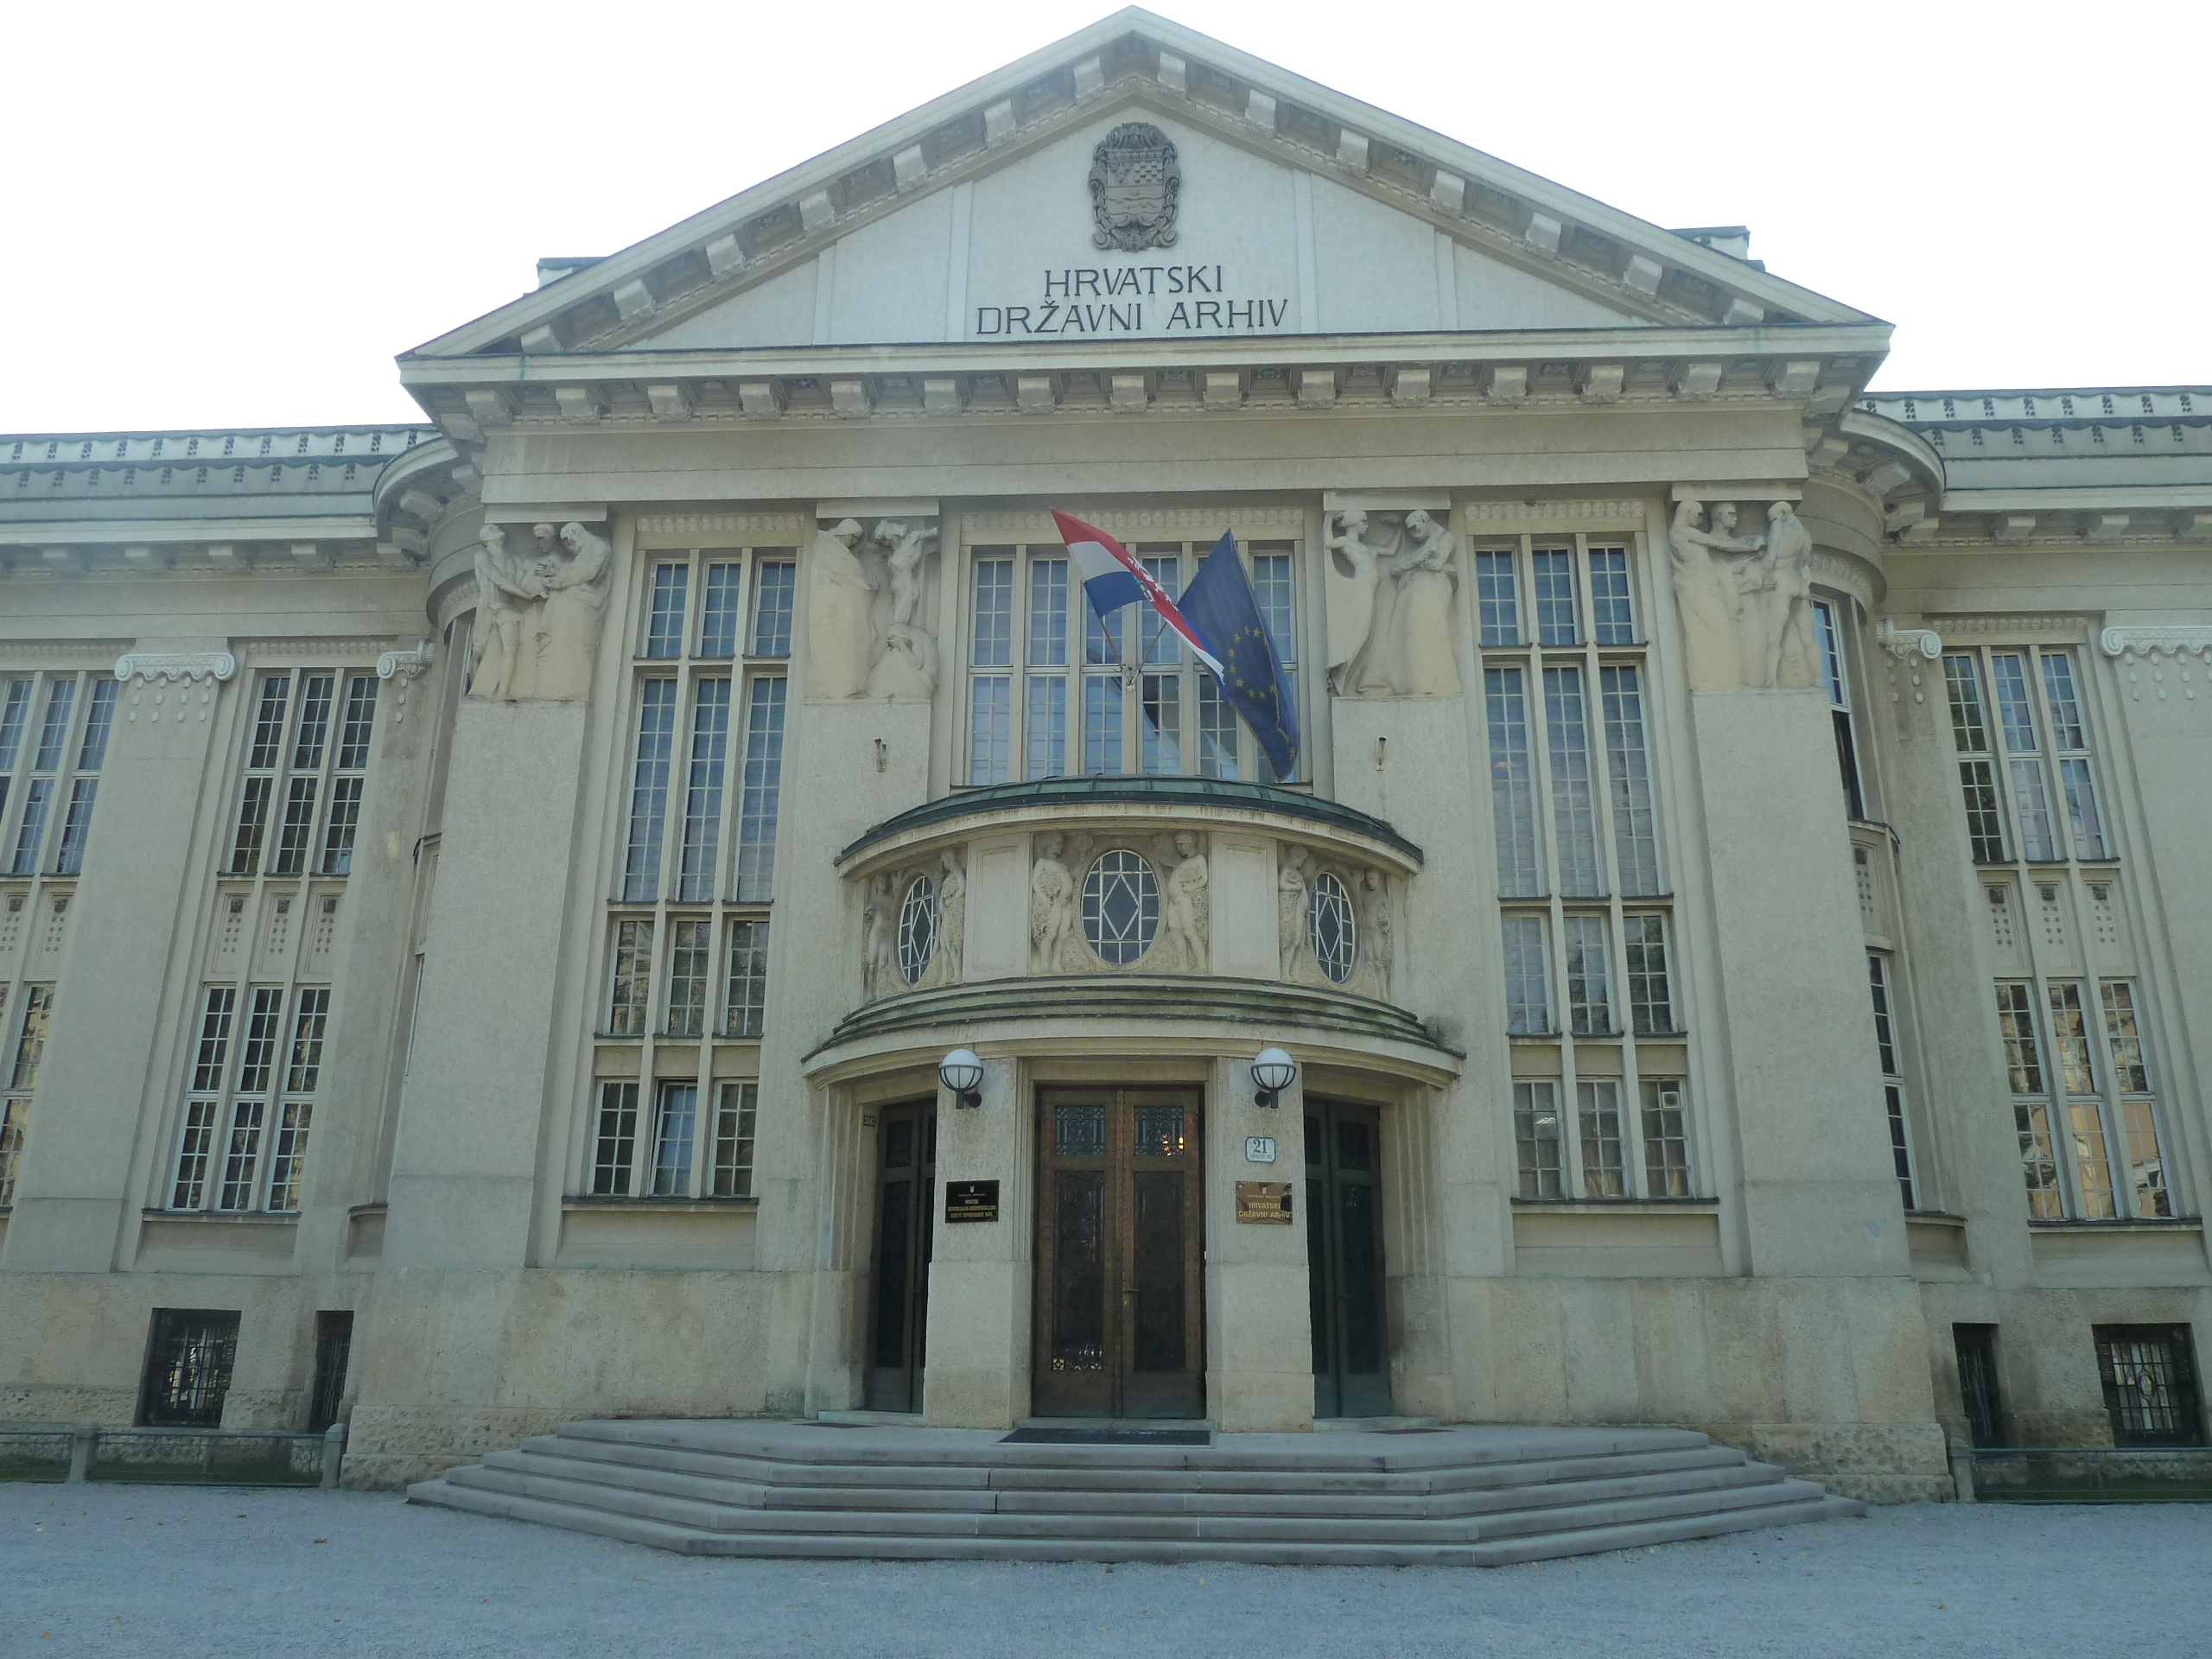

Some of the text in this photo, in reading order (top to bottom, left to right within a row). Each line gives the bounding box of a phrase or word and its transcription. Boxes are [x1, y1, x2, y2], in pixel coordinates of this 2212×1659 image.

[1044, 265, 1223, 297] HRVATSKI
[976, 299, 1287, 334] DRŽAVNI ARHIV
[1253, 1138, 1268, 1154] 21
[1238, 1210, 1268, 1218] DRŽAVNI
